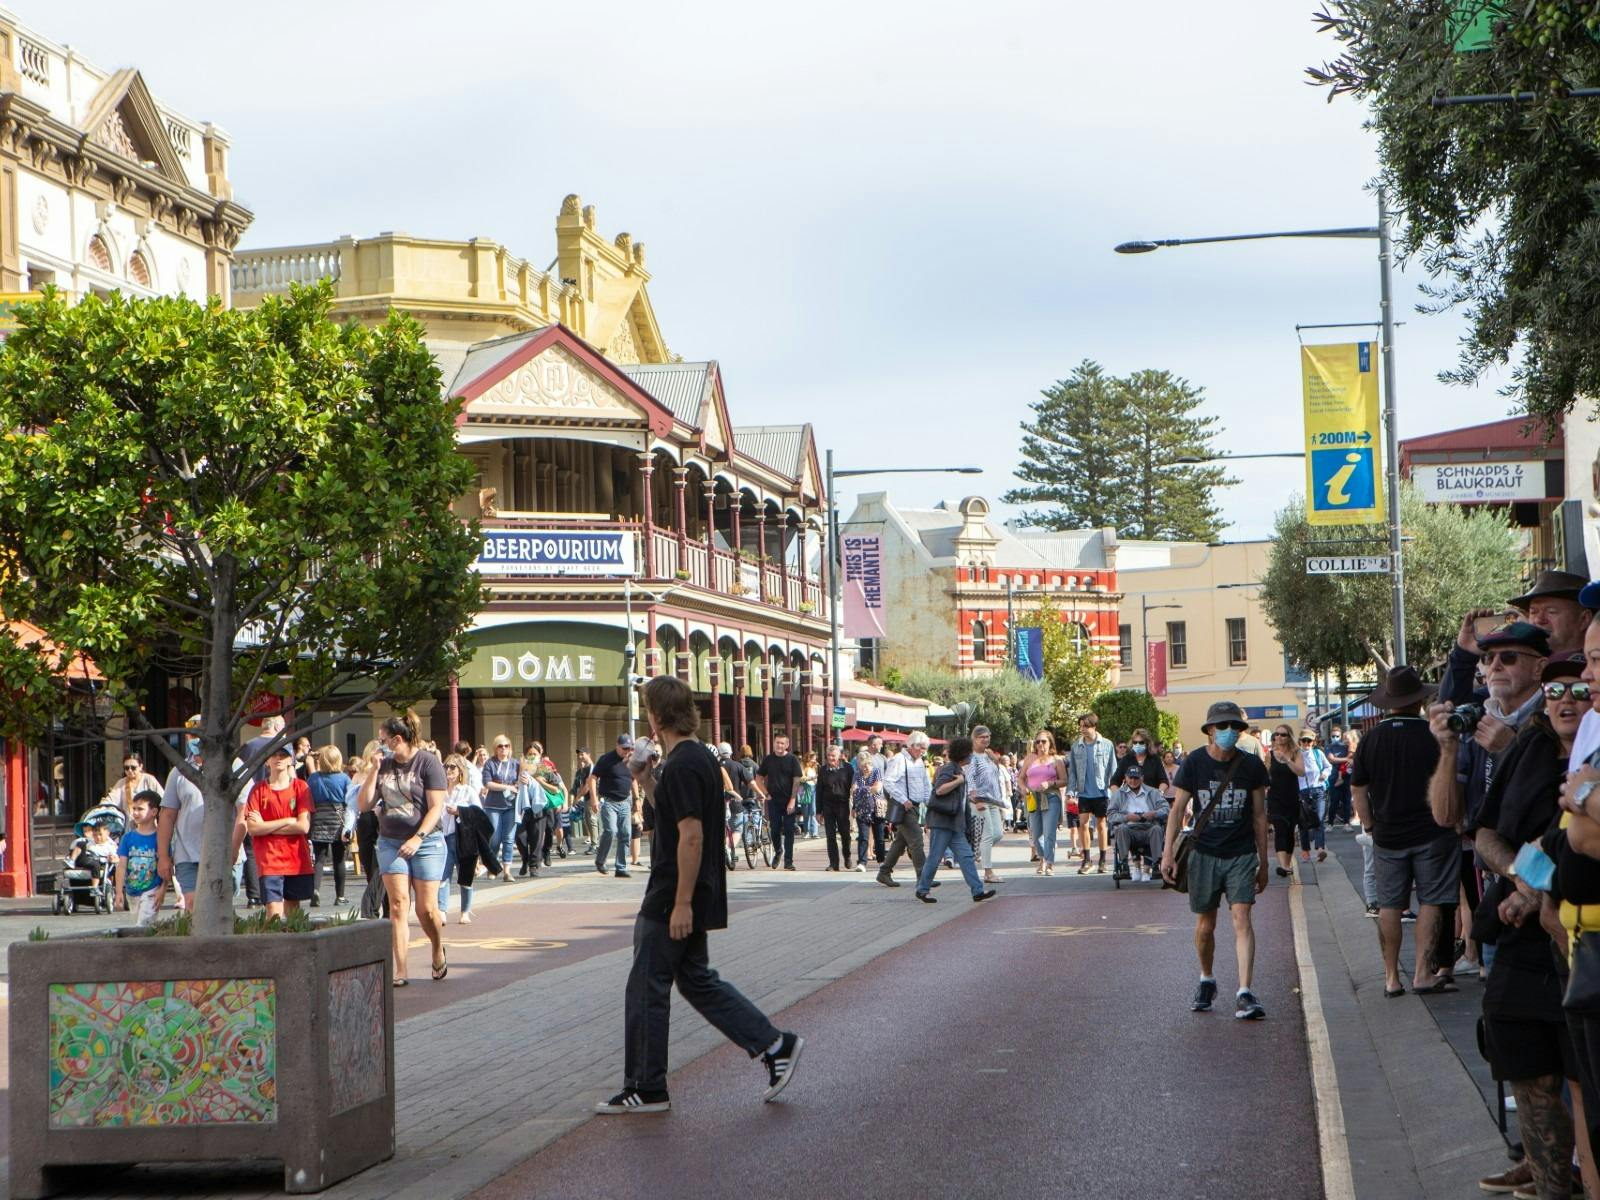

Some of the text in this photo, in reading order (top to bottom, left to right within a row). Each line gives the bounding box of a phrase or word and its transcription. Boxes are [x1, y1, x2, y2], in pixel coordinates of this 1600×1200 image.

[1319, 431, 1356, 444] 200M
[1437, 476, 1523, 490] BLAUKRAUT
[483, 538, 619, 561] BEERPOURIUM
[845, 538, 862, 582] THIS IS
[863, 538, 881, 608] FREMANTLE
[1308, 559, 1367, 572] COLLIE
[491, 651, 594, 681] DÔME
